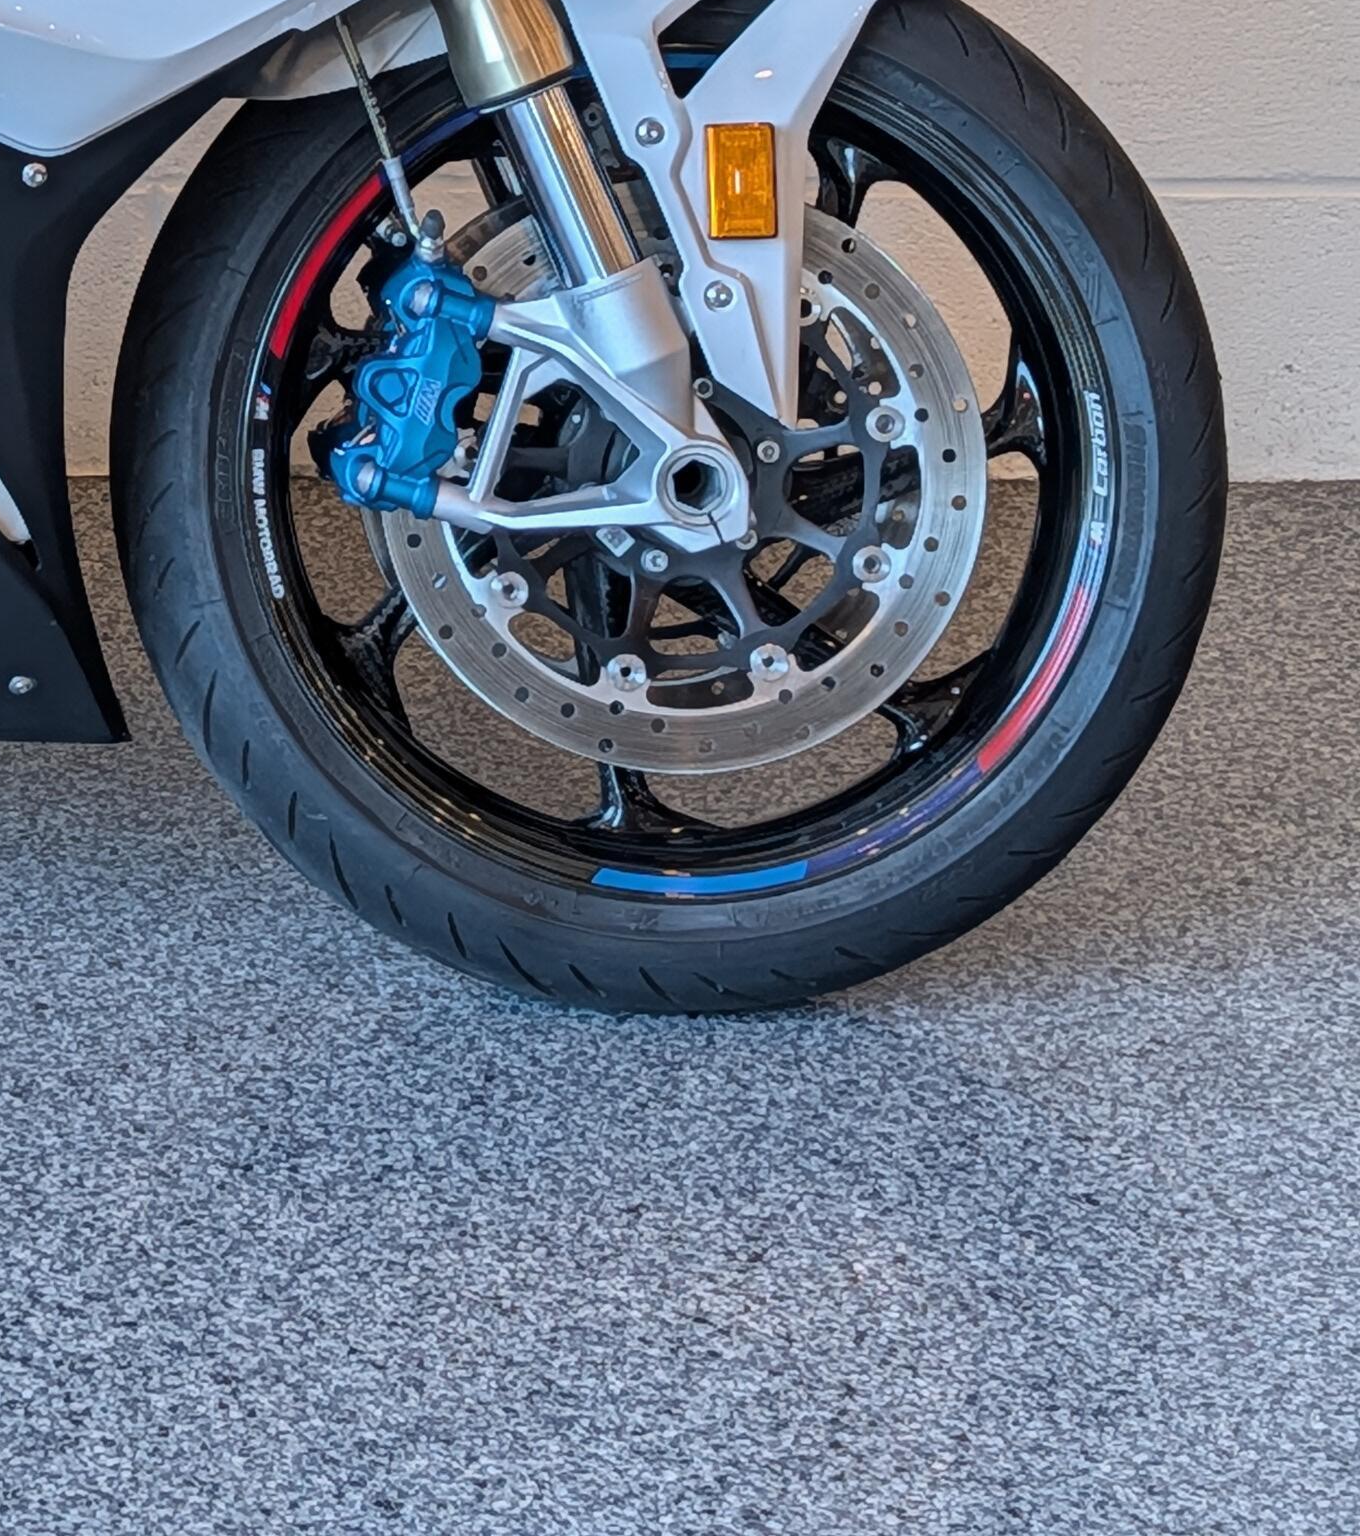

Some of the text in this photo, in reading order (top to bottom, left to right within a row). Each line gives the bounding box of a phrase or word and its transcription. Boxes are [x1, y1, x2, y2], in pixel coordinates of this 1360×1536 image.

[251, 448, 266, 496] BMW
[1083, 389, 1109, 498] Carbon
[253, 498, 286, 600] MOTORRAD
